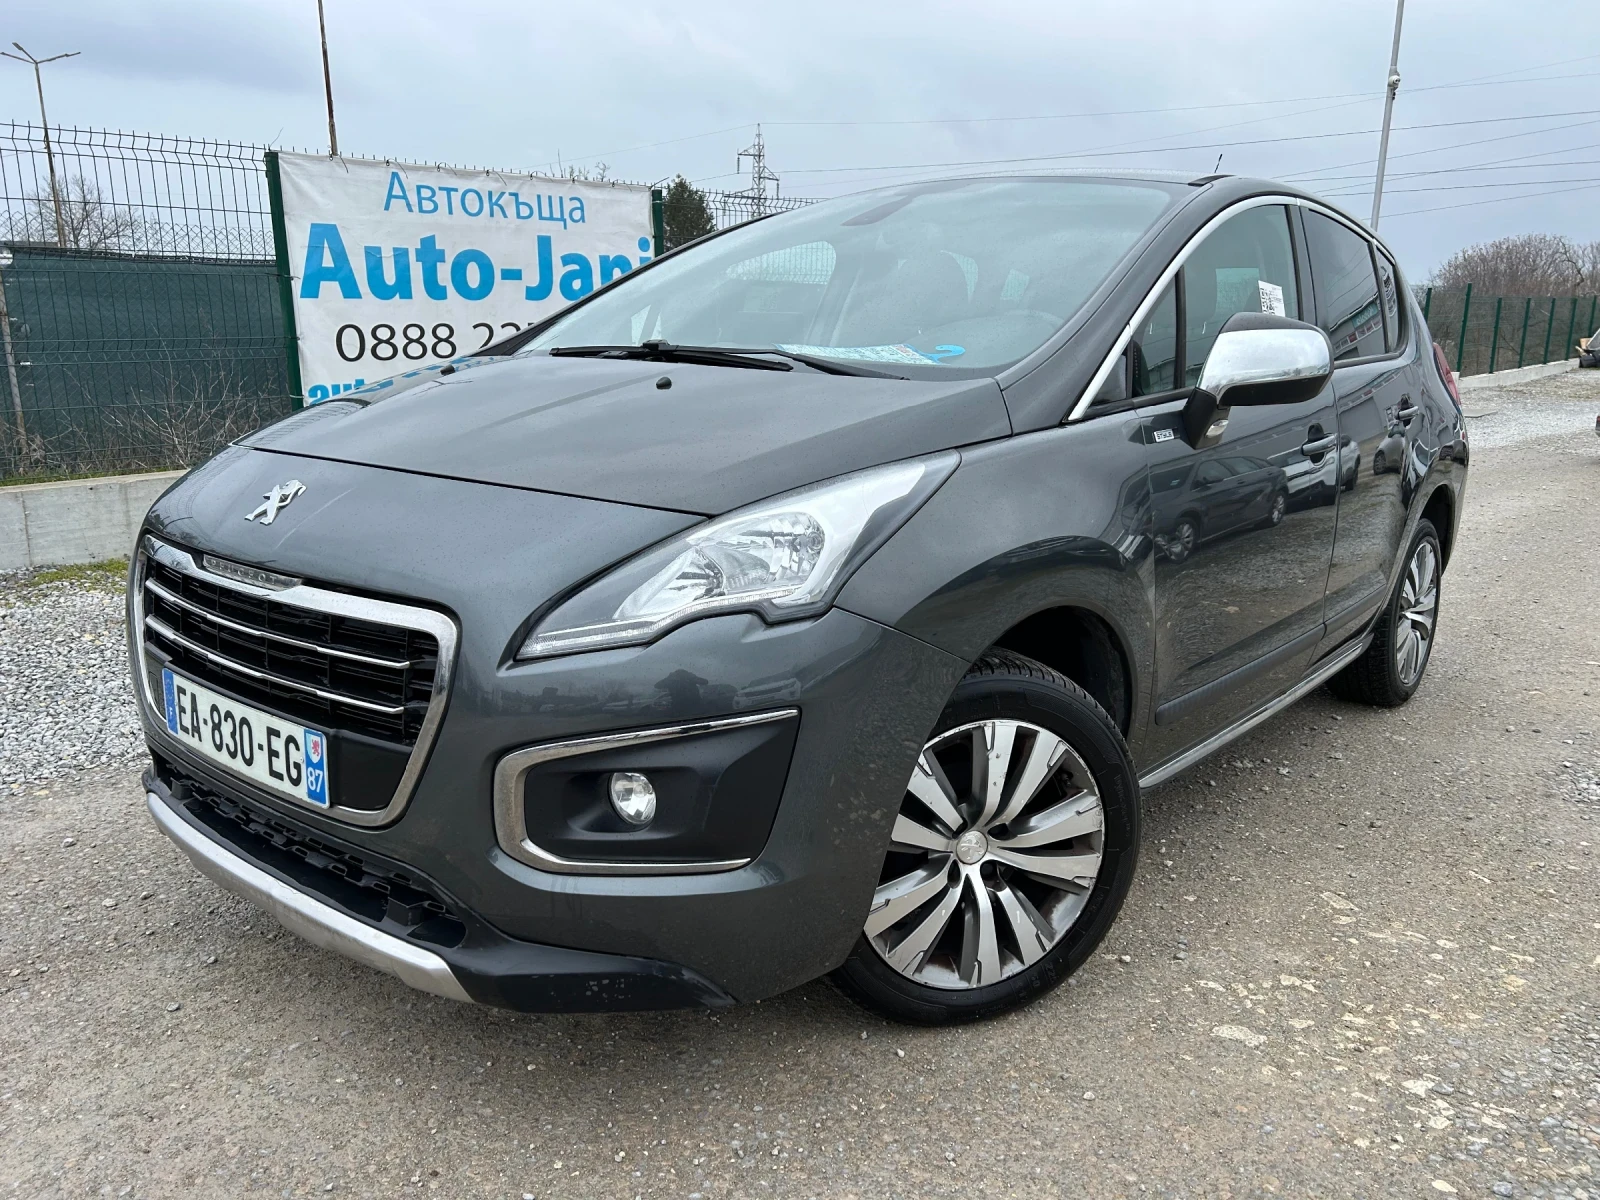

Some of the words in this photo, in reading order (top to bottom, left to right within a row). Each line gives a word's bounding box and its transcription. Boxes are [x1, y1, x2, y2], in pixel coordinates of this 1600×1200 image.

[384, 171, 586, 230] Автокъща
[335, 322, 456, 362] 0888
[176, 685, 302, 787] EA-830-EG
[307, 767, 323, 793] 87
